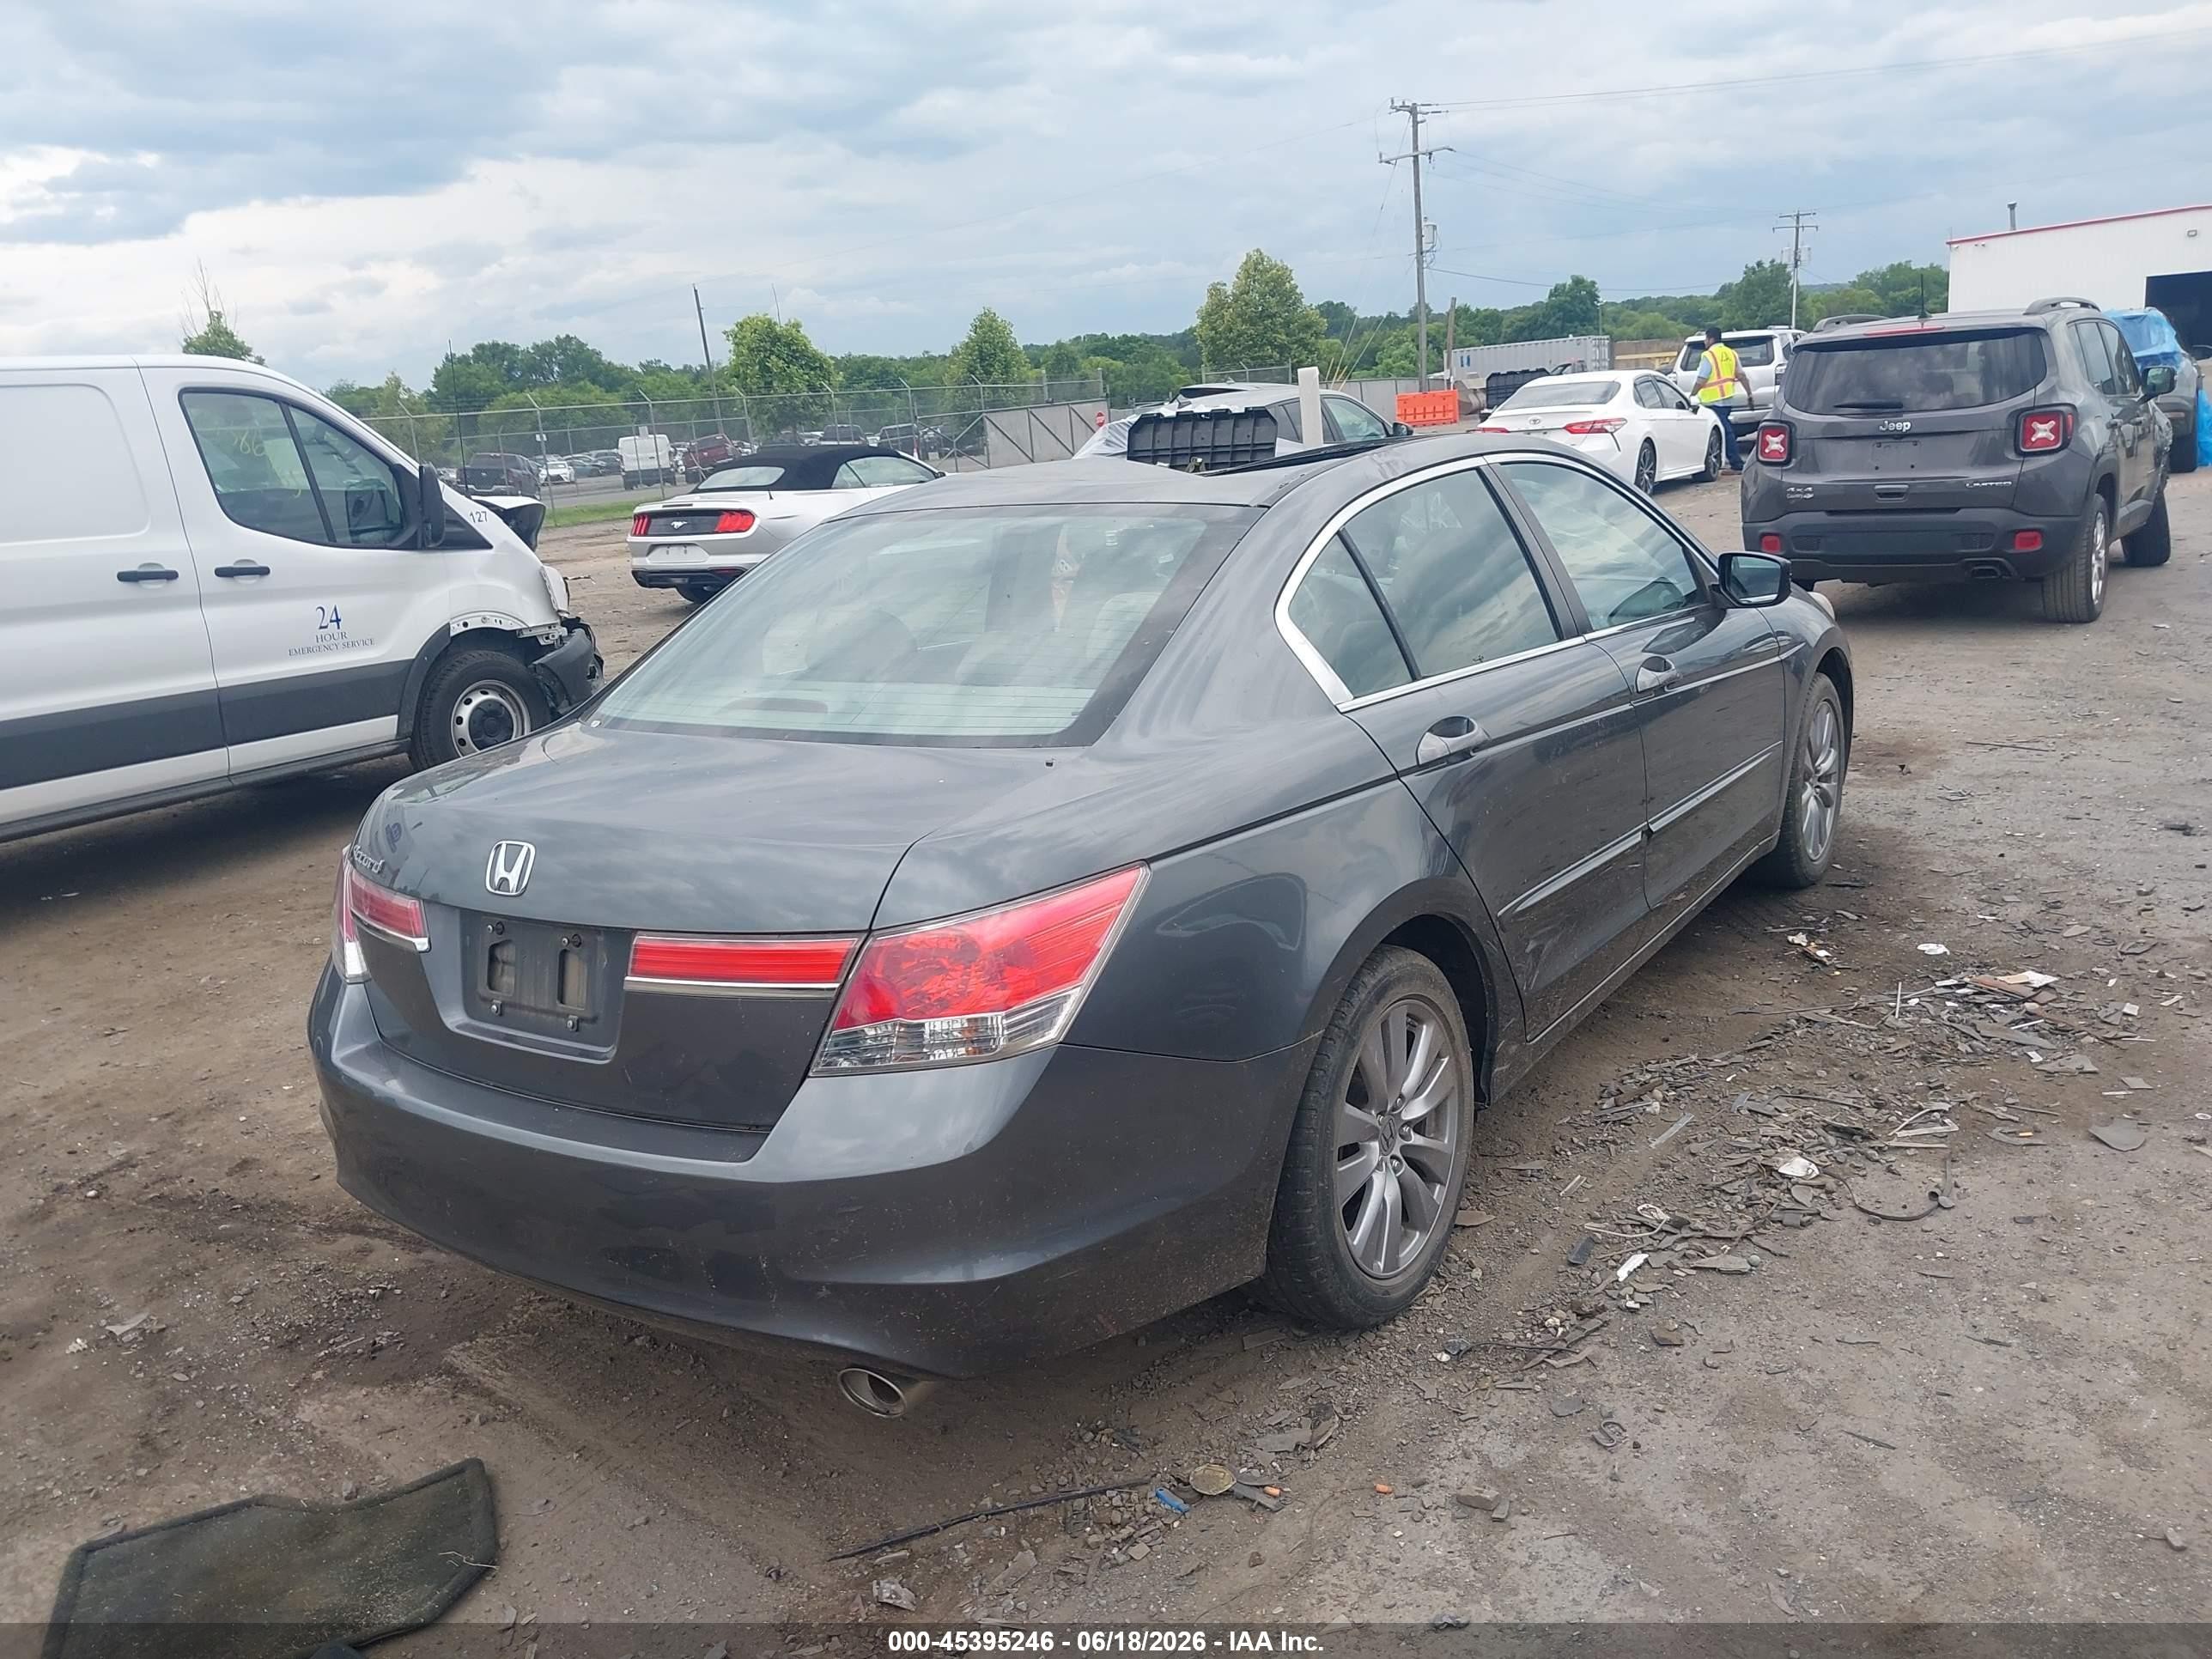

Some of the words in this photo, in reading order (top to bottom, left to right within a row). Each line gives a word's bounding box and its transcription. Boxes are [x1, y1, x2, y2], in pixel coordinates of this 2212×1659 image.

[1879, 420, 1911, 433] Jeep
[469, 510, 488, 523] 127
[315, 604, 342, 629] 24
[315, 631, 348, 643] HOUR
[289, 642, 340, 656] EMERGENCY
[342, 638, 375, 649] SERVICE
